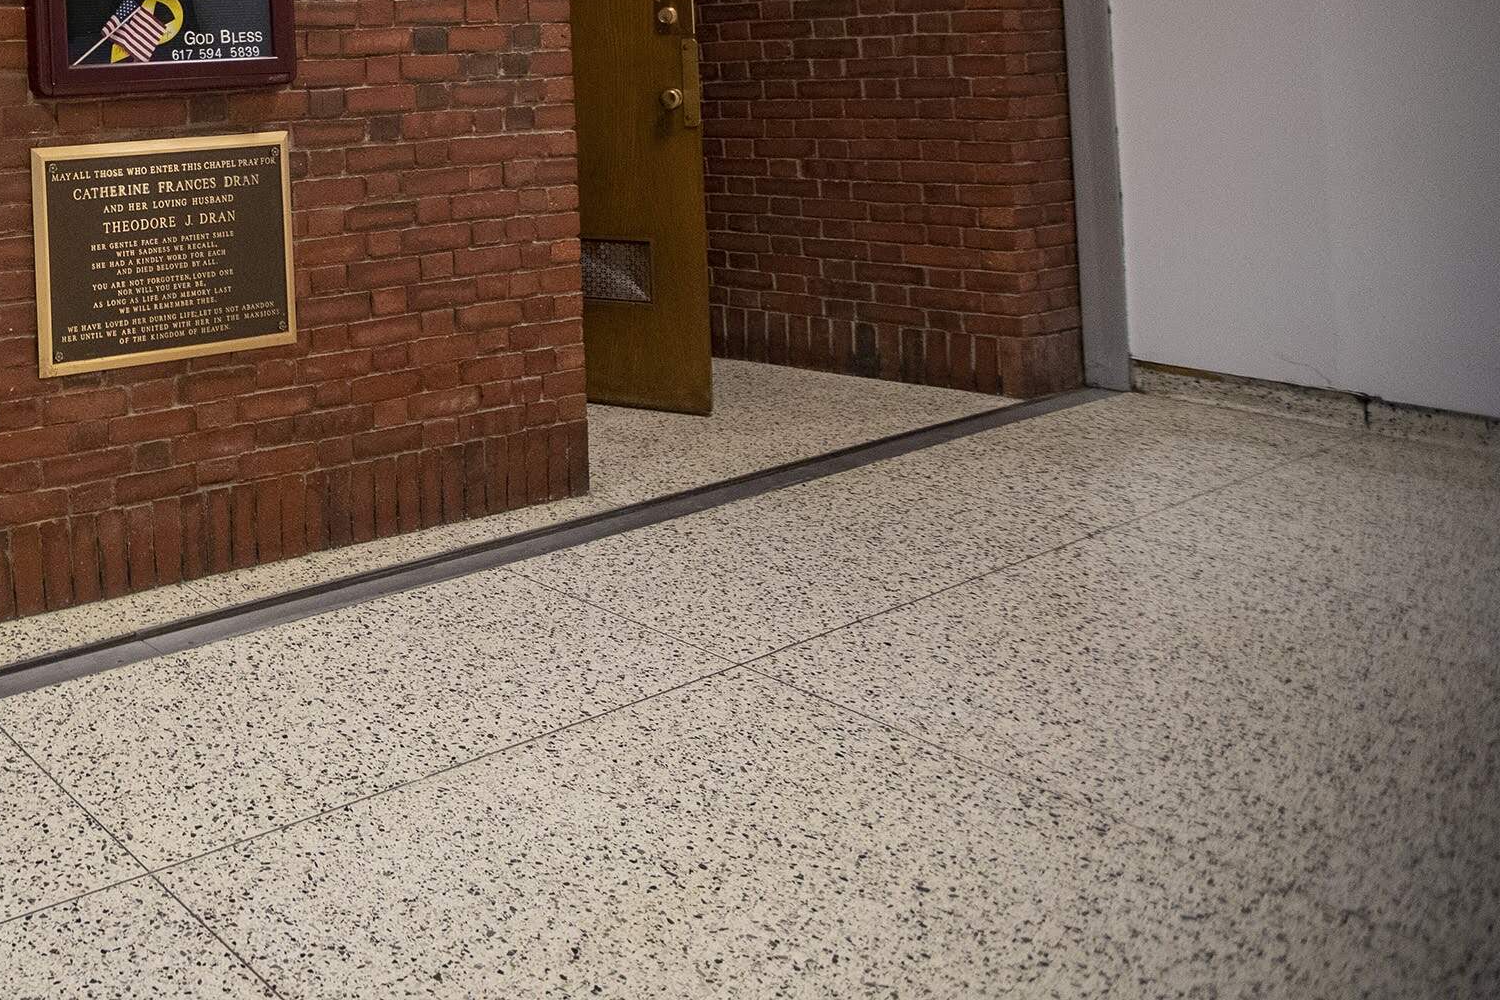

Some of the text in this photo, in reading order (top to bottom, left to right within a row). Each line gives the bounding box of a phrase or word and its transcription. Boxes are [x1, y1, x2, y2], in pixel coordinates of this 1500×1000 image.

[184, 29, 262, 46] GOD BLESS
[172, 46, 260, 61] 617 594 5839
[52, 173, 72, 182] MAY
[73, 171, 91, 180] ALL
[94, 168, 124, 178] THOSE
[126, 166, 147, 176] WHO
[150, 164, 180, 174] ENTER
[182, 162, 202, 171] THIS
[204, 160, 236, 170] CHAPEL
[238, 158, 258, 167] PRAY
[73, 174, 259, 200] CATHERINE FRANCES DRAN
[104, 194, 234, 214] AND HER LOVING HUSBAND
[103, 210, 236, 234] THEODORE J. DRAN
[109, 240, 138, 249] GENTLE
[181, 233, 210, 242] PATIENT
[212, 230, 234, 238] SMILE
[92, 262, 106, 270] SHE
[136, 256, 164, 265] KINDLY
[208, 249, 226, 257] EACH
[138, 246, 170, 256] SADNESS
[156, 262, 188, 271] BELOVED
[192, 271, 216, 280] LOVED
[180, 288, 211, 298] MEMORY
[154, 300, 194, 310] REMEMBER
[82, 323, 102, 332] HAVE
[105, 320, 129, 328] LOVED
[150, 314, 176, 322] DURING
[200, 309, 212, 317] LET
[242, 300, 274, 311] ABANDON
[80, 332, 103, 340] UNTIL
[122, 328, 136, 336] ARE
[140, 324, 168, 333] UNITED
[195, 318, 210, 326] HER
[132, 335, 146, 343] THE
[150, 330, 184, 340] KINGDOM
